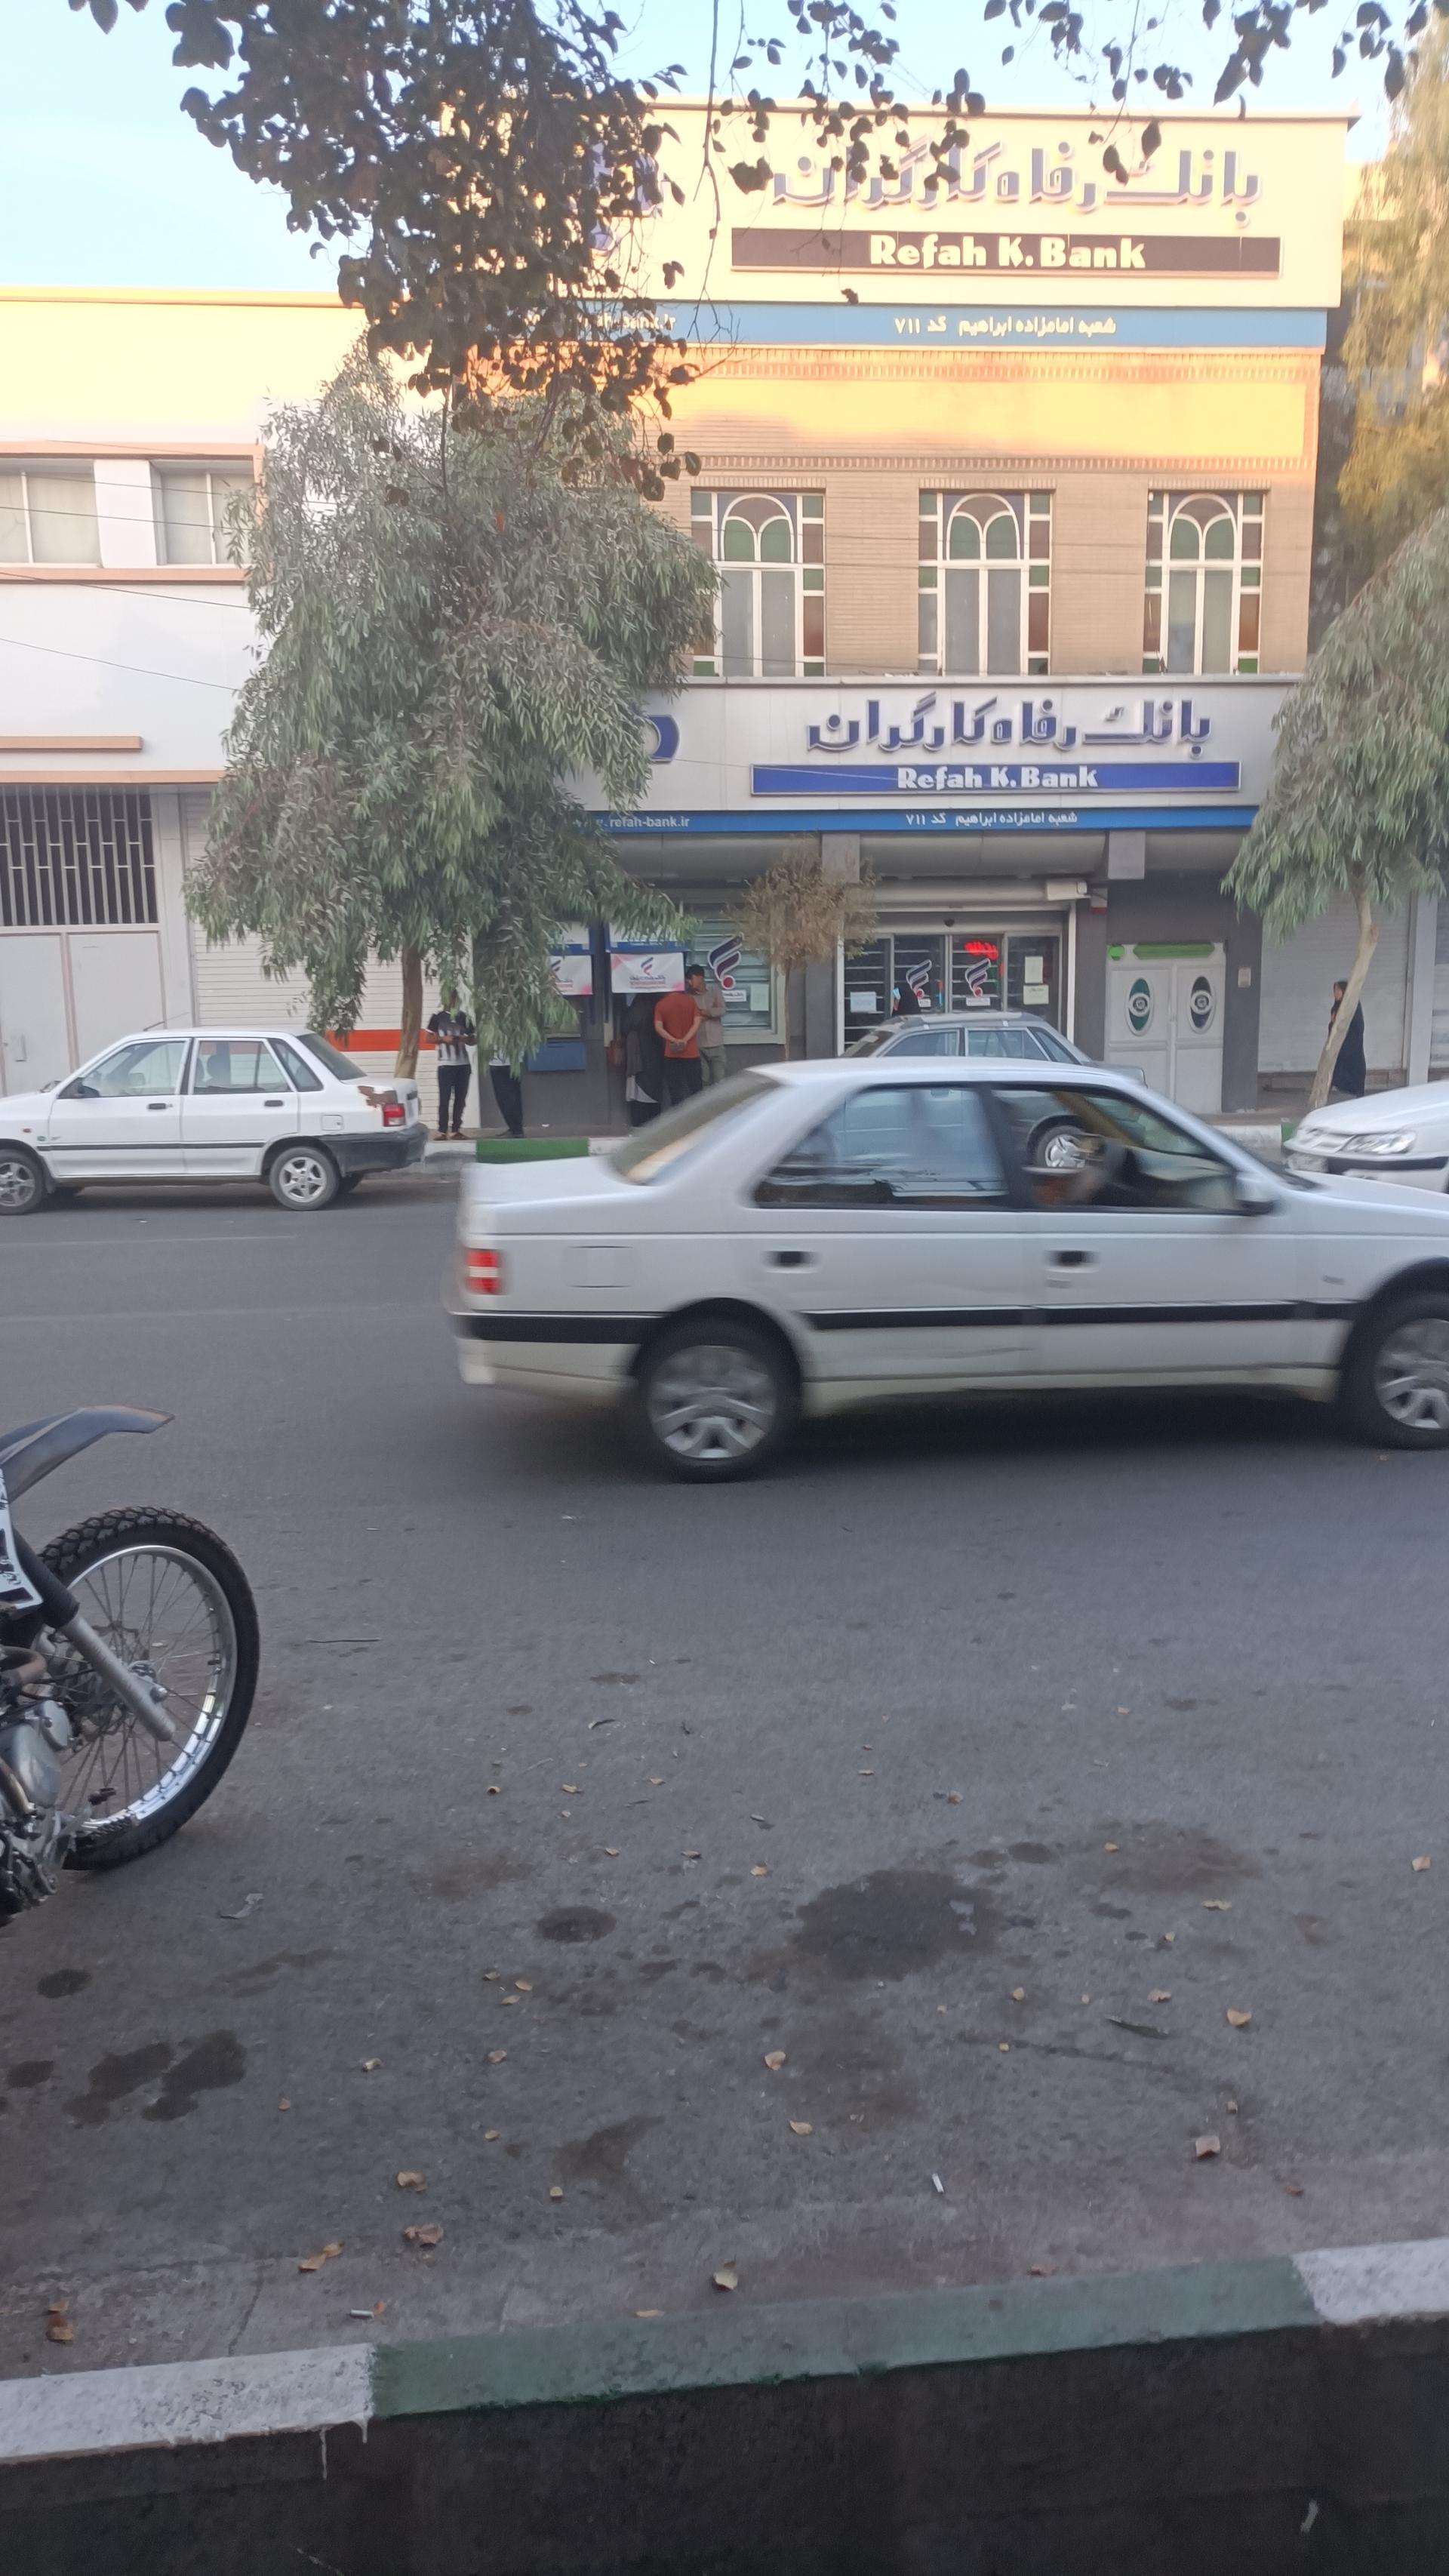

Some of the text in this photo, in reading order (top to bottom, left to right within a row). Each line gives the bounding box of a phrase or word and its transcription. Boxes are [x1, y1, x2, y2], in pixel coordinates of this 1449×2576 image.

[995, 140, 1097, 214] رفاه
[1103, 147, 1260, 227] بانک
[870, 234, 986, 269] Refah
[927, 315, 947, 333] کد
[1078, 317, 1117, 337] شعبه
[807, 691, 1211, 758] بانک رفاه کارگران
[897, 766, 983, 791] Refah
[931, 811, 947, 824] کد
[1048, 811, 1078, 827] شعبه
